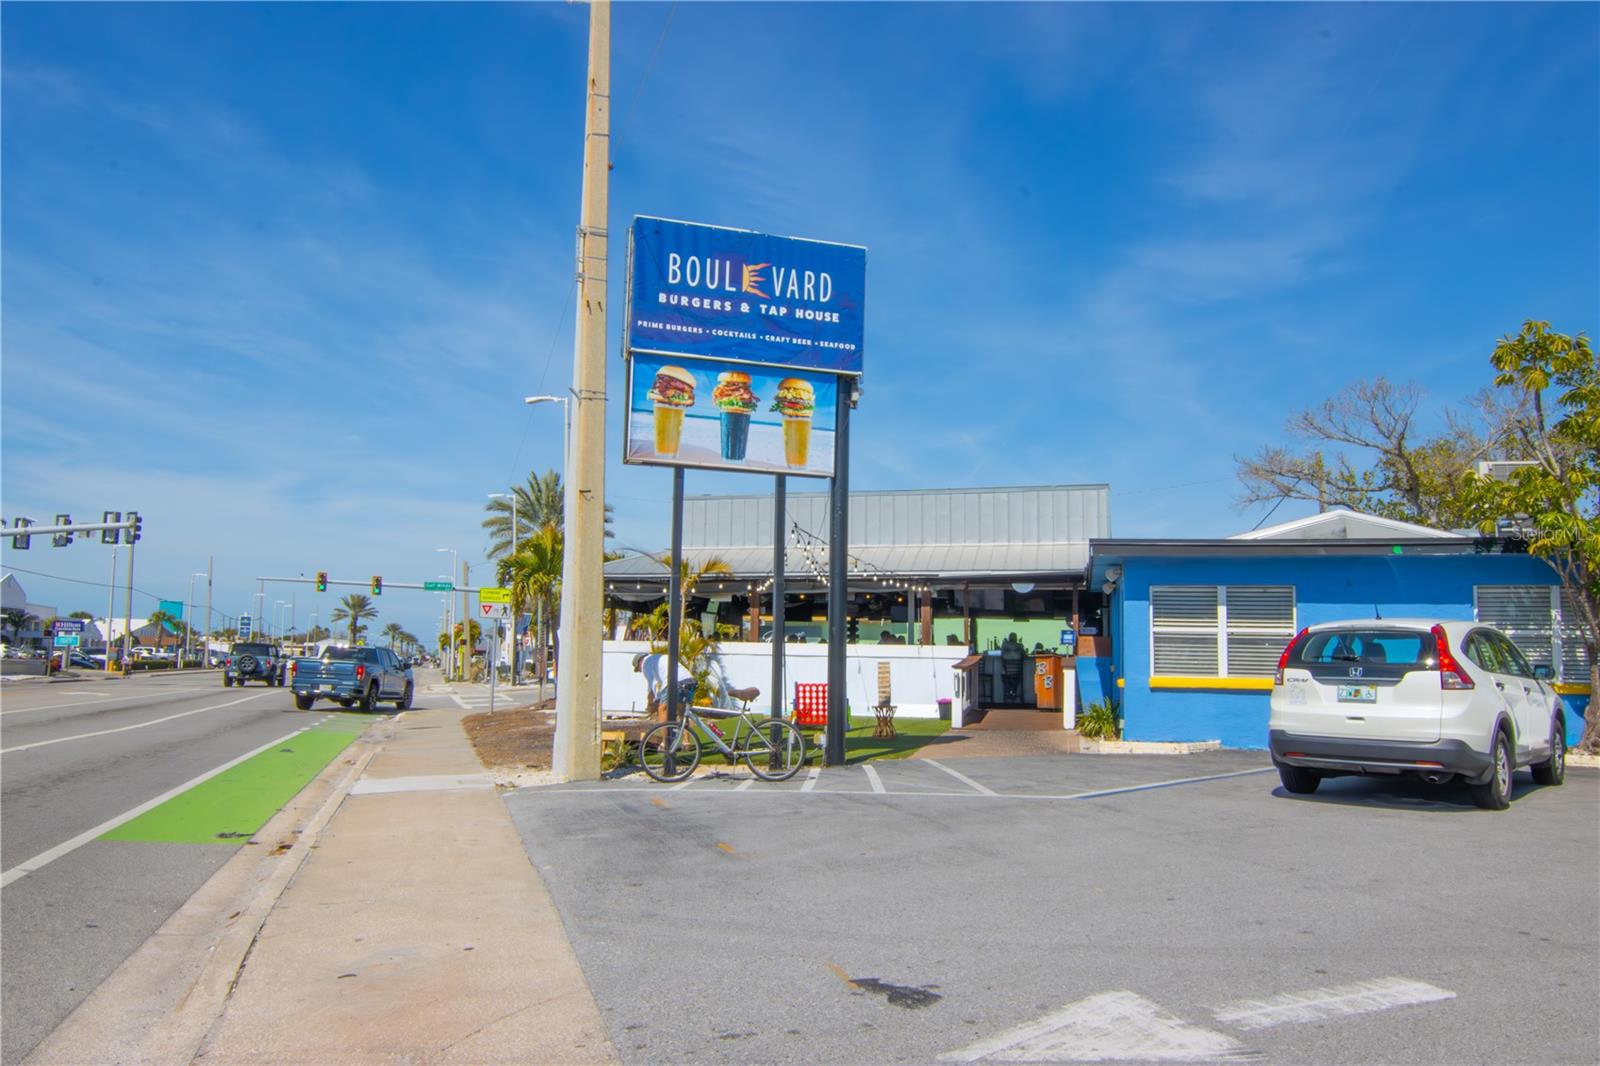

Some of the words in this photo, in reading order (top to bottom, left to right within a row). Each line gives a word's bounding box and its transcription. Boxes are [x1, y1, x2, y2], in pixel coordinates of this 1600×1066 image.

[668, 253, 832, 303] BOULEVARD
[658, 292, 732, 312] BURGERS
[740, 302, 750, 313] &
[760, 304, 787, 317] TAP
[795, 308, 840, 323] HOUSE
[637, 320, 664, 330] PRIME
[665, 323, 703, 335] BURGERS
[711, 329, 757, 340] COCKTAILS
[765, 334, 791, 344] CRAFT
[792, 338, 812, 346] BEER
[819, 340, 856, 351] SEAFOOD
